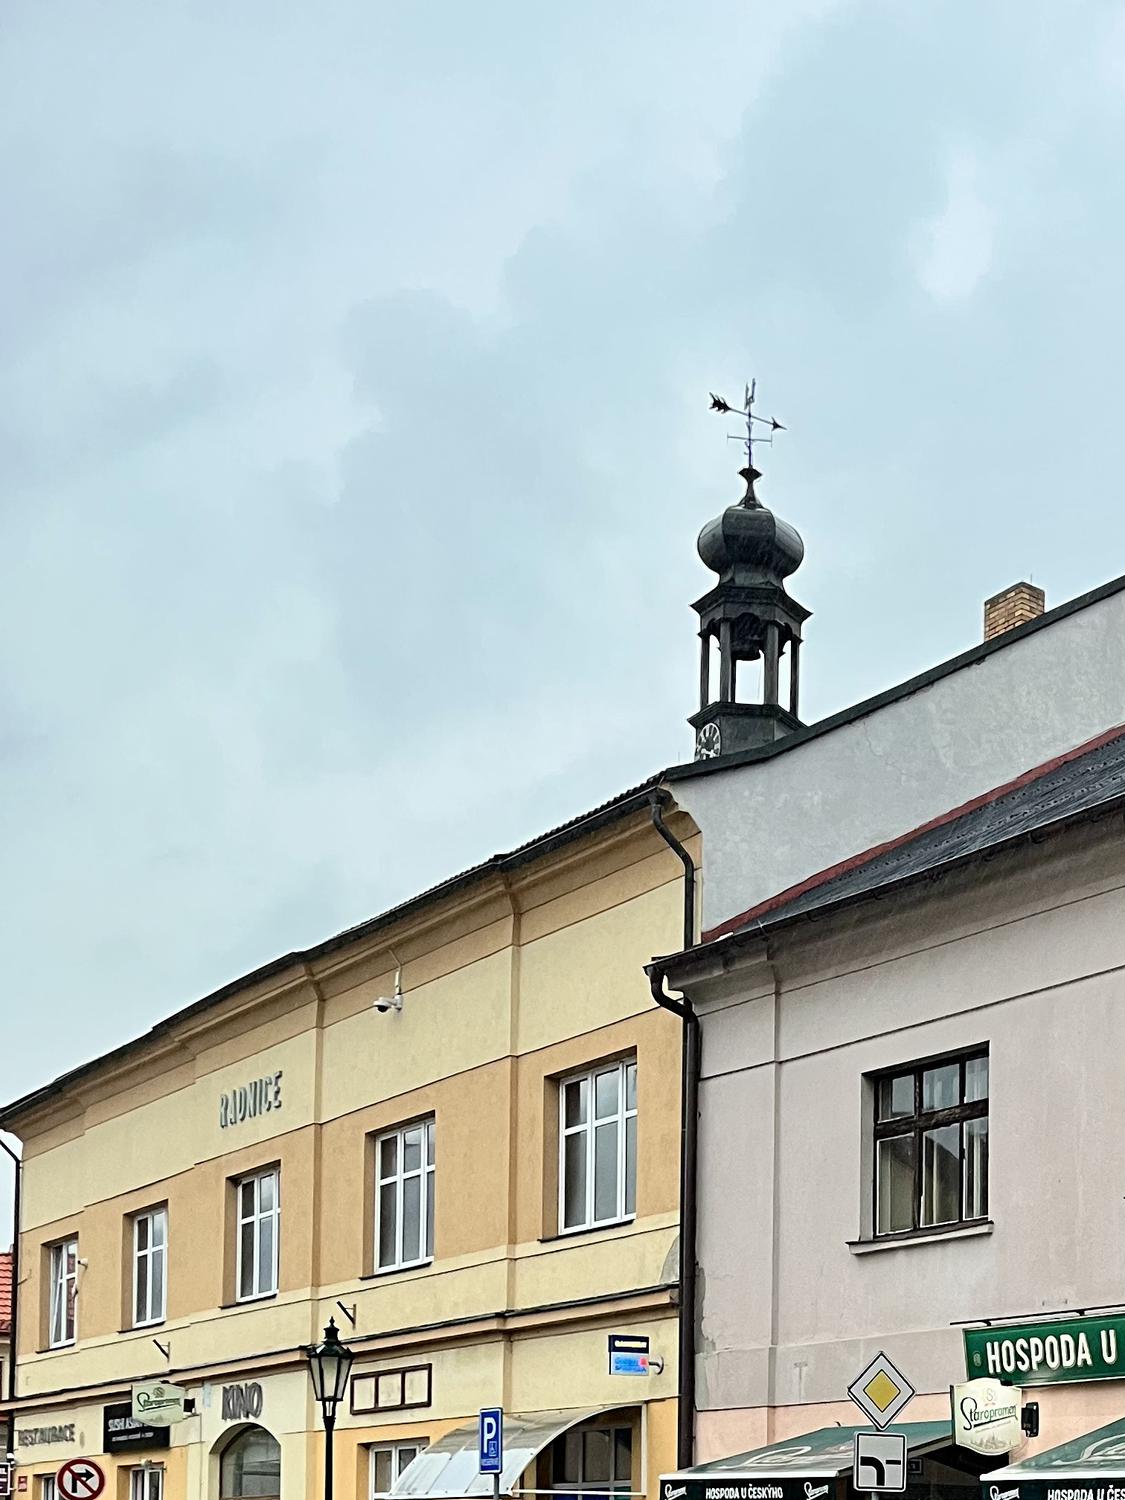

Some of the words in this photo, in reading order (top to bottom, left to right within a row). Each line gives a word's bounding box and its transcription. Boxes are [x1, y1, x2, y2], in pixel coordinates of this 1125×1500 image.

[220, 1070, 283, 1128] RADNICE
[985, 1332, 1094, 1375] HOSPODA
[1100, 1329, 1117, 1366] U
[221, 1382, 264, 1420] KINO
[960, 1396, 1019, 1431] Staropramen
[483, 1416, 497, 1454] P
[705, 1486, 741, 1500] HOSPODA
[740, 1487, 747, 1499] U
[748, 1483, 783, 1500] ČESKÝHO
